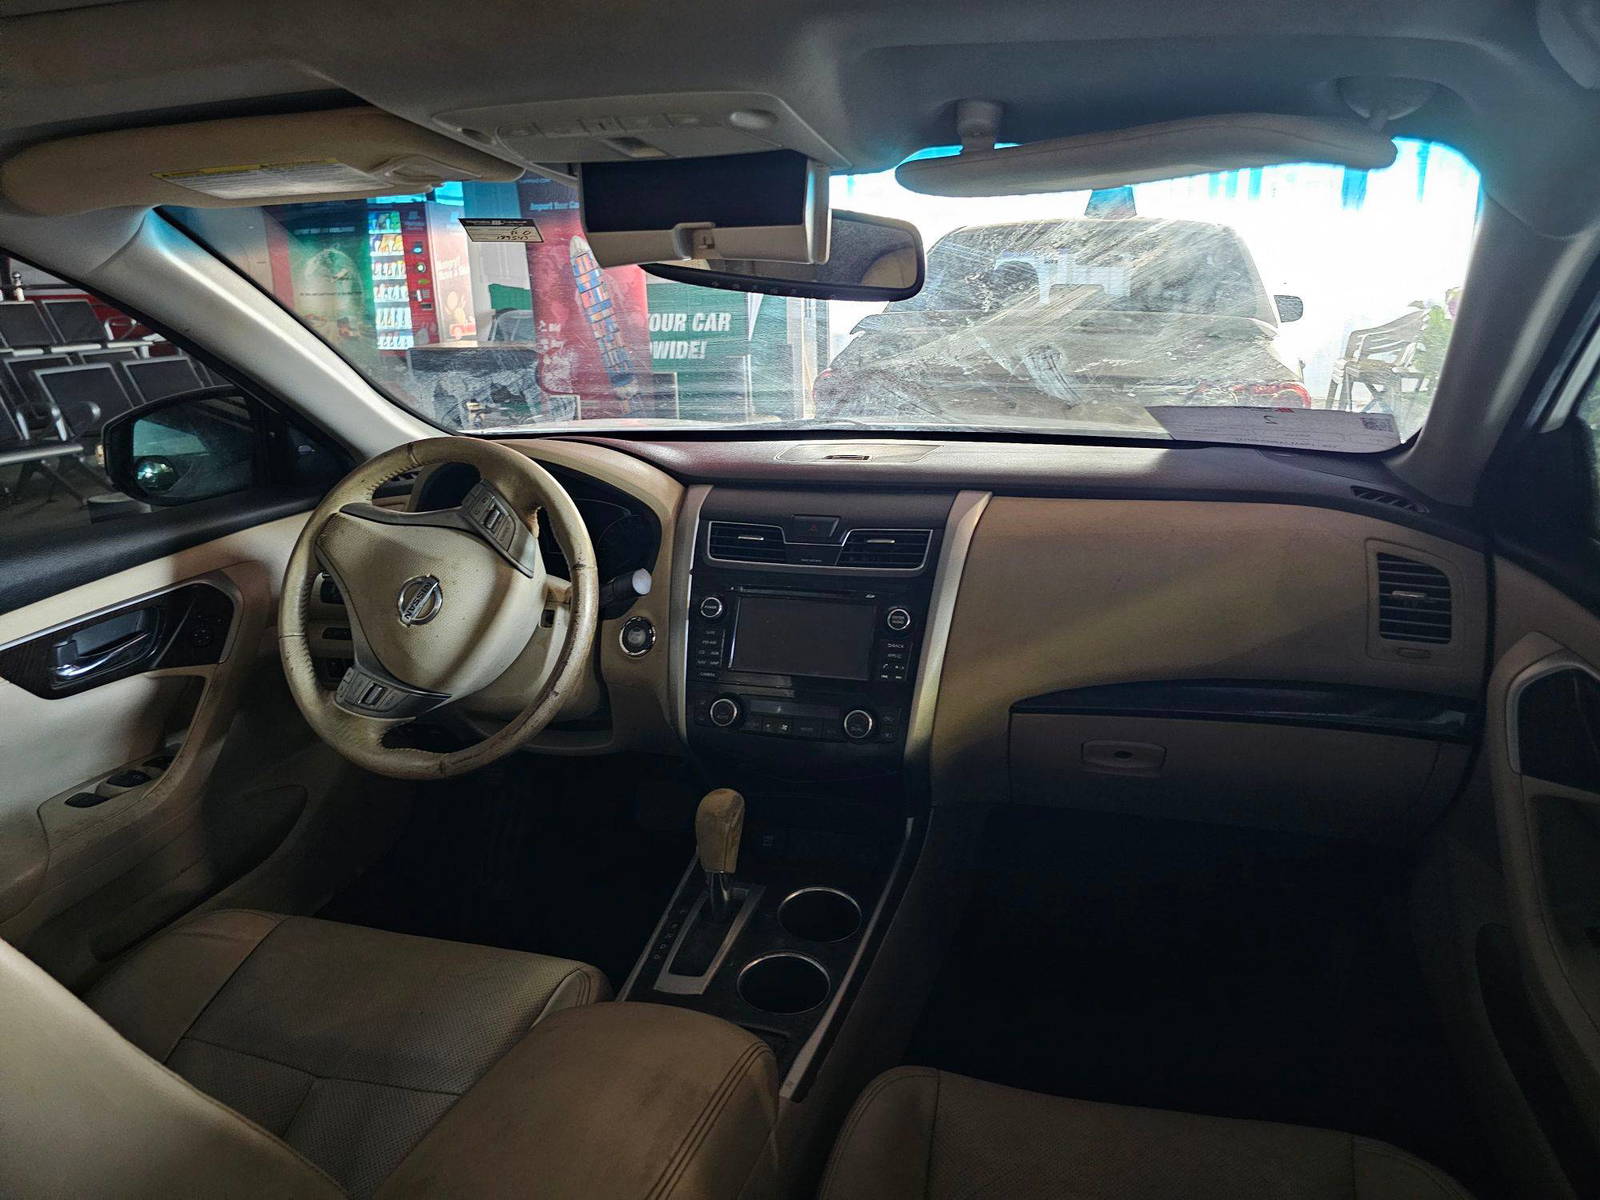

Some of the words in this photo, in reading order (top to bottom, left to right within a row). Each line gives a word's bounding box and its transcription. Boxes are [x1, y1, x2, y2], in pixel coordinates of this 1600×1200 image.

[648, 312, 688, 332] OUR
[692, 312, 732, 332] CAR
[650, 340, 708, 360] WIDE!
[404, 581, 432, 620] NISSAN
